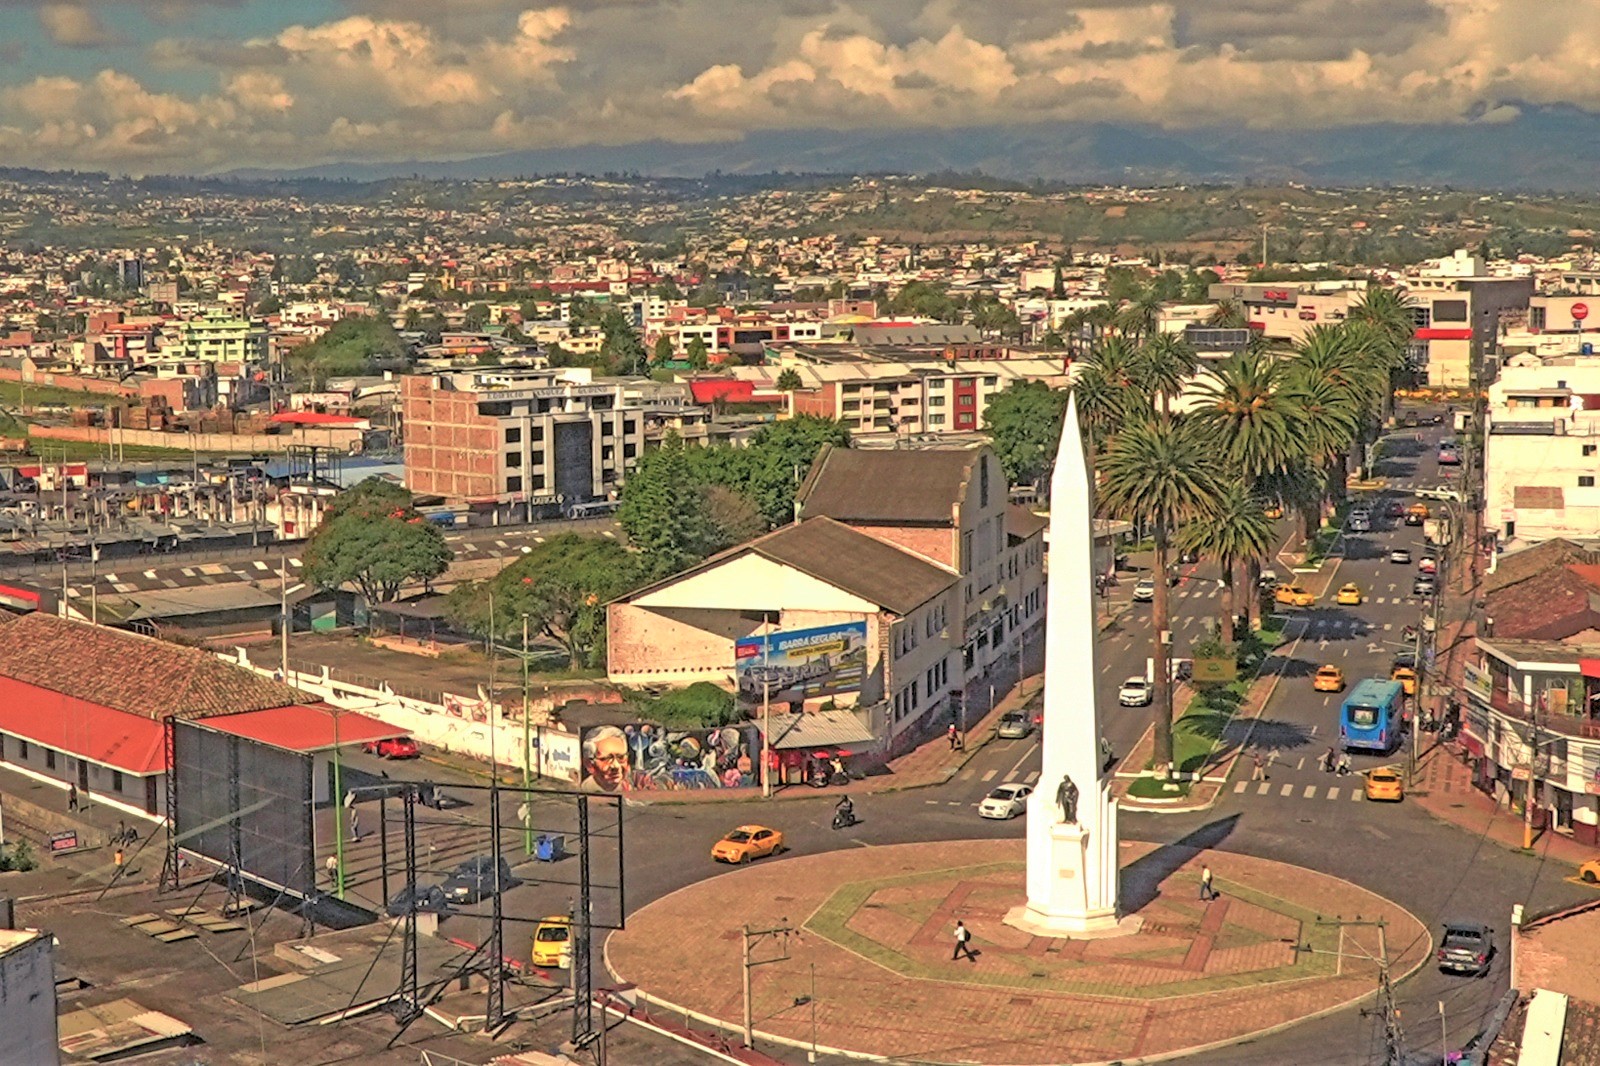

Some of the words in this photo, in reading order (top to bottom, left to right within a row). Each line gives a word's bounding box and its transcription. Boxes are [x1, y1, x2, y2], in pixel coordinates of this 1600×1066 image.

[487, 391, 524, 400] EDIFICIO
[778, 636, 809, 651] IBARRA
[809, 631, 843, 645] SEGURA
